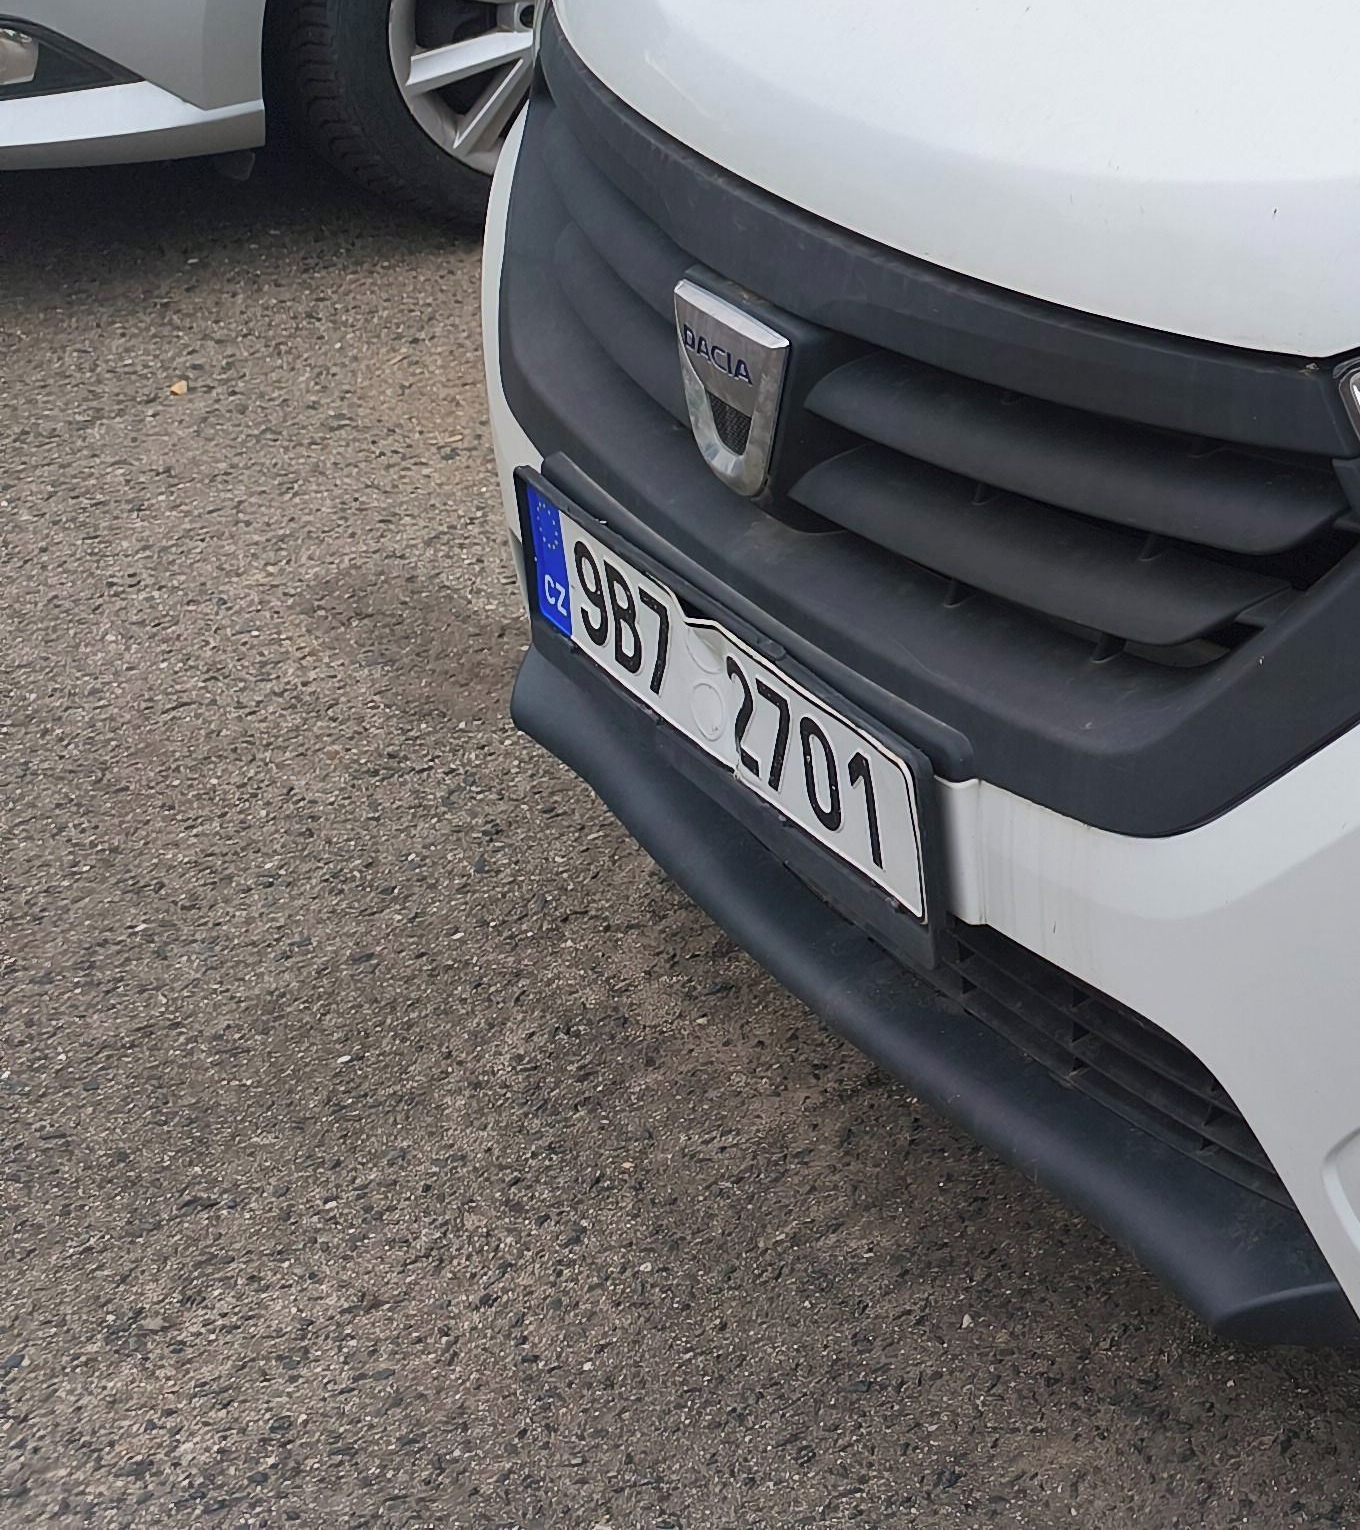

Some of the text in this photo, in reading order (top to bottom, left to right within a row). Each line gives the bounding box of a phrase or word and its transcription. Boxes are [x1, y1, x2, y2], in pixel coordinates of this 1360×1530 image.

[683, 324, 754, 385] DACIA
[544, 574, 568, 617] CZ
[574, 539, 884, 871] 9B7 2701
